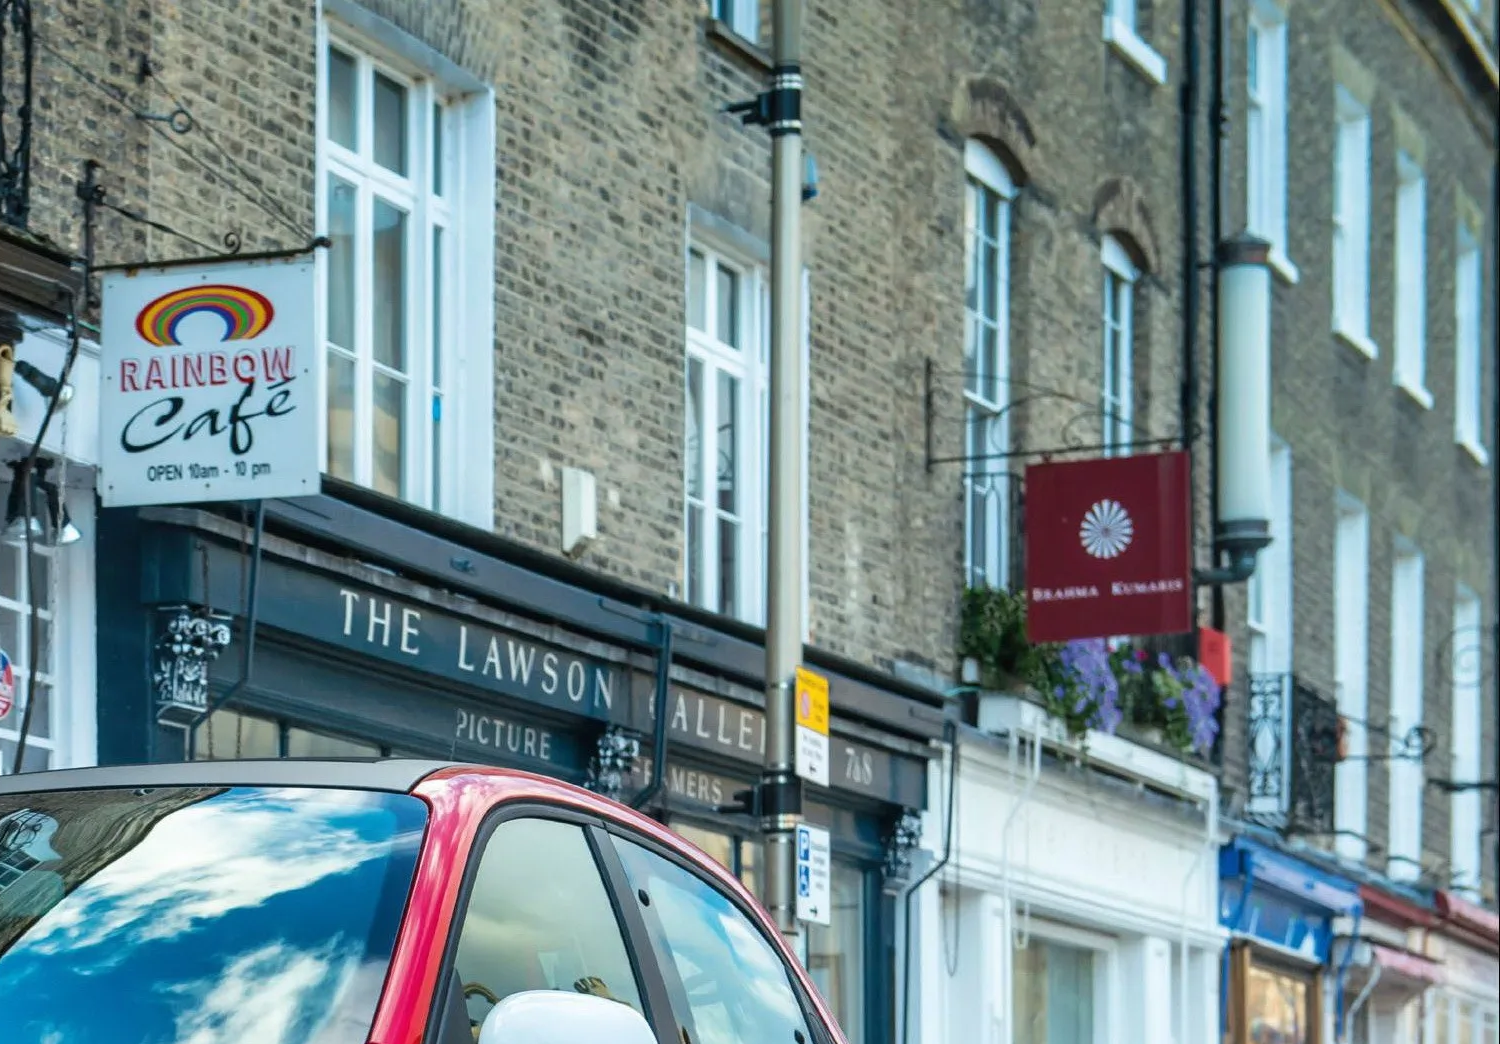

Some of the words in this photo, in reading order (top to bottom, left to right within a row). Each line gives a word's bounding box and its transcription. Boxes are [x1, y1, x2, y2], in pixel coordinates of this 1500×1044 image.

[120, 346, 295, 393] RAINBOW
[121, 376, 296, 456] Café
[147, 463, 183, 482] OPEN
[189, 463, 220, 479] 10am
[235, 461, 247, 477] 10
[252, 462, 271, 480] pm
[340, 588, 422, 657] THE
[457, 624, 614, 711] LAWSON
[649, 684, 765, 756] ALLE
[456, 707, 551, 760] PICTURE
[643, 759, 723, 805] FMERS
